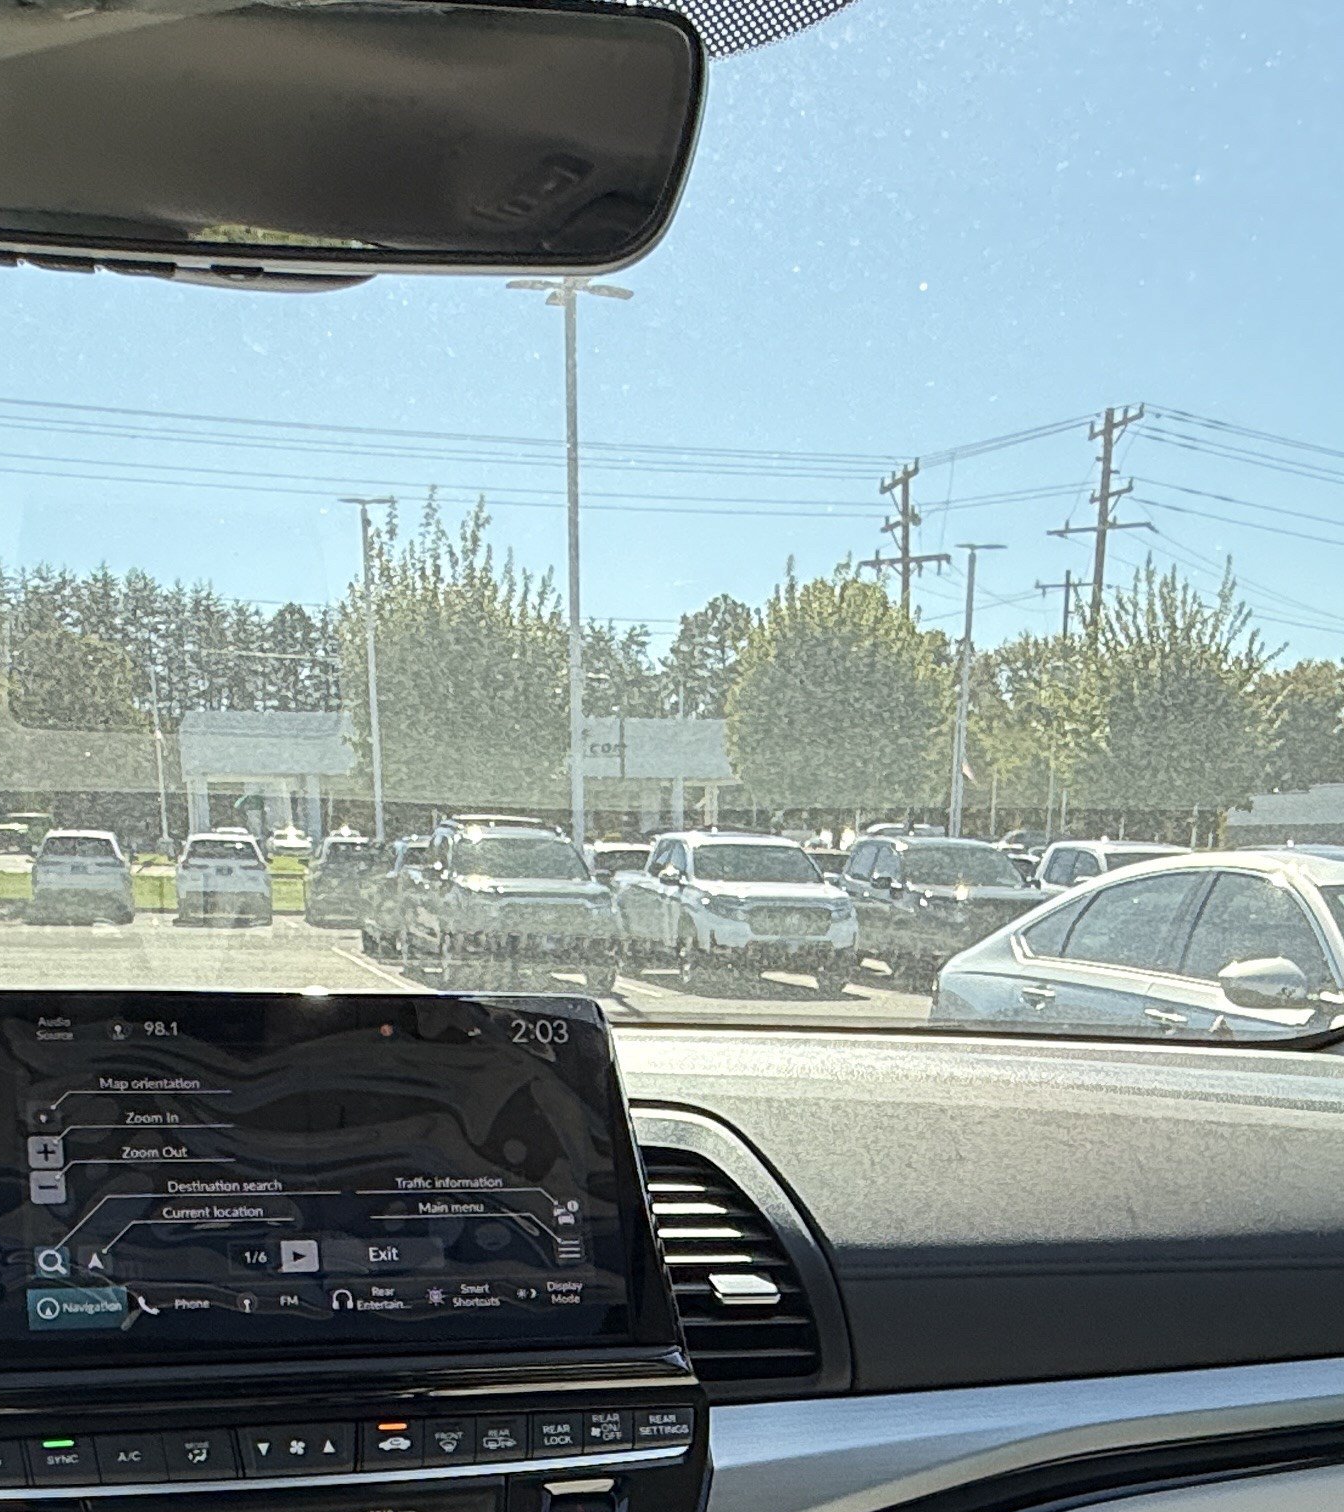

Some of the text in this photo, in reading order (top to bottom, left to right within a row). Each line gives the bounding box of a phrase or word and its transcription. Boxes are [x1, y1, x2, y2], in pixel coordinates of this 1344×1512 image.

[143, 1020, 179, 1037] 98.1
[510, 1019, 570, 1043] 2:03
[99, 1077, 200, 1091] Map orientation
[125, 1111, 180, 1124] Zoom In
[122, 1146, 188, 1159] Zoom Out
[167, 1180, 283, 1193] Destination search
[395, 1176, 503, 1189] Traffic information
[162, 1206, 264, 1219] Current location
[418, 1202, 485, 1214] Main menu
[244, 1250, 268, 1264] 1/6
[369, 1247, 400, 1261] Exit
[371, 1286, 395, 1297] Rear
[460, 1283, 490, 1294] Smart
[546, 1281, 583, 1293] Display
[174, 1298, 210, 1310] Phone
[279, 1294, 299, 1307] FM
[452, 1297, 501, 1308] Shortcuts
[551, 1293, 581, 1304] Mode
[62, 1301, 123, 1315] Navigation
[592, 1413, 620, 1423] REAR
[648, 1414, 676, 1424] REAR
[487, 1429, 511, 1438] REAR
[542, 1424, 571, 1434] REAR
[639, 1424, 689, 1436] SETTINGS
[435, 1431, 463, 1441] FRONT
[544, 1435, 573, 1445] LOCK
[46, 1454, 78, 1465] SYNC
[118, 1450, 142, 1462] A/C
